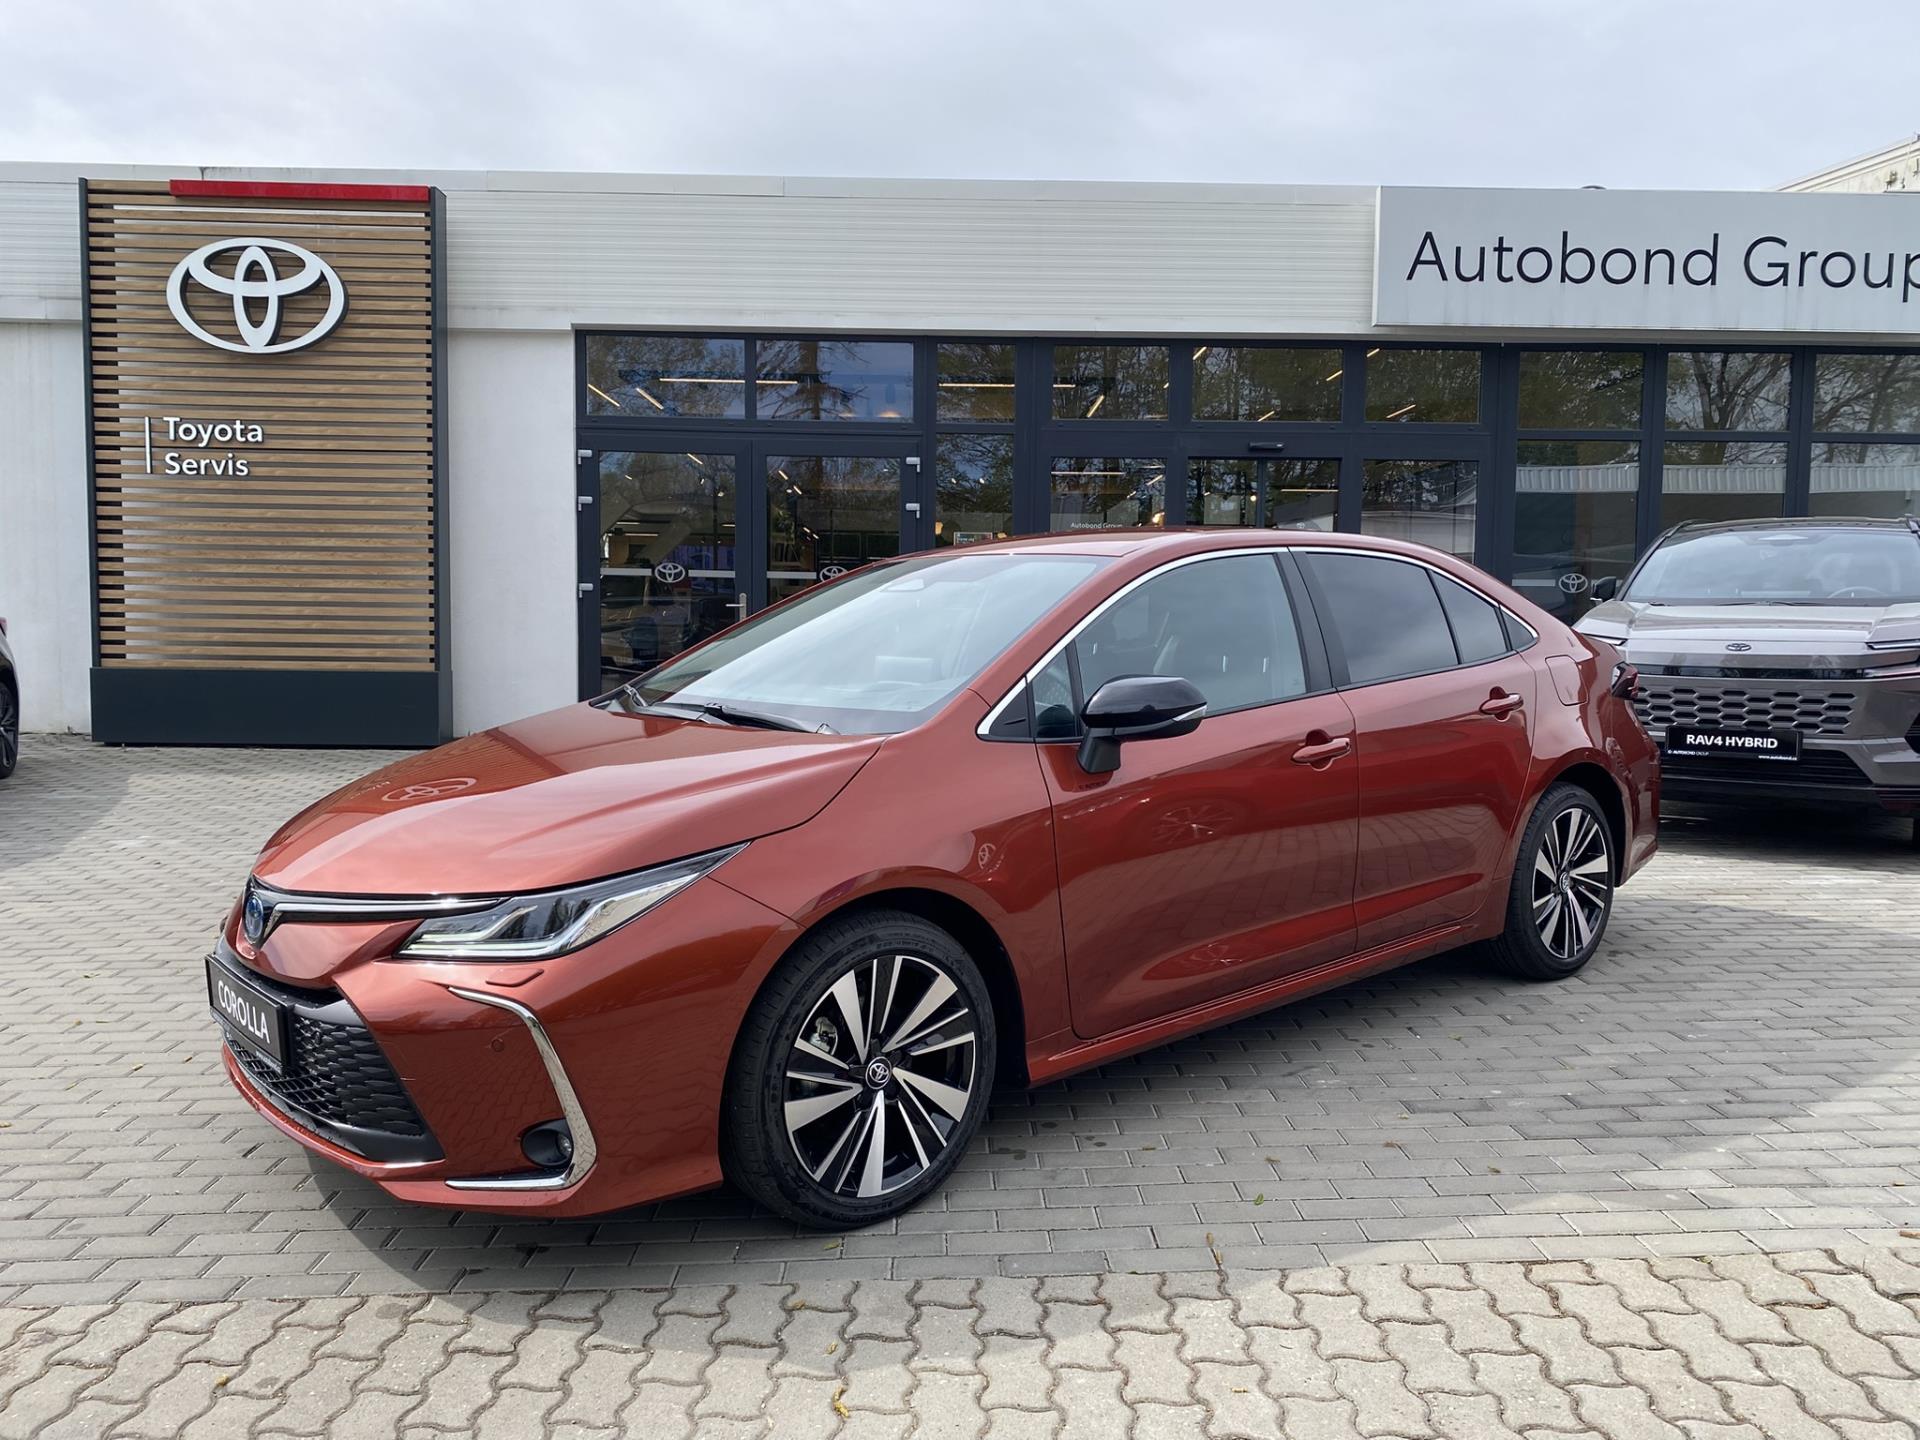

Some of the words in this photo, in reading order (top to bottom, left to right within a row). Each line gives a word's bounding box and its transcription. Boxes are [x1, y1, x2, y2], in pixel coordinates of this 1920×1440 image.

[1406, 230, 1720, 287] Autobond
[162, 416, 264, 448] Toyota
[164, 452, 249, 476] Servis
[1070, 521, 1102, 529] Autobond
[1686, 734, 1723, 746] RAV4
[1725, 736, 1778, 749] HYBRID
[218, 980, 271, 1044] COROLLA
